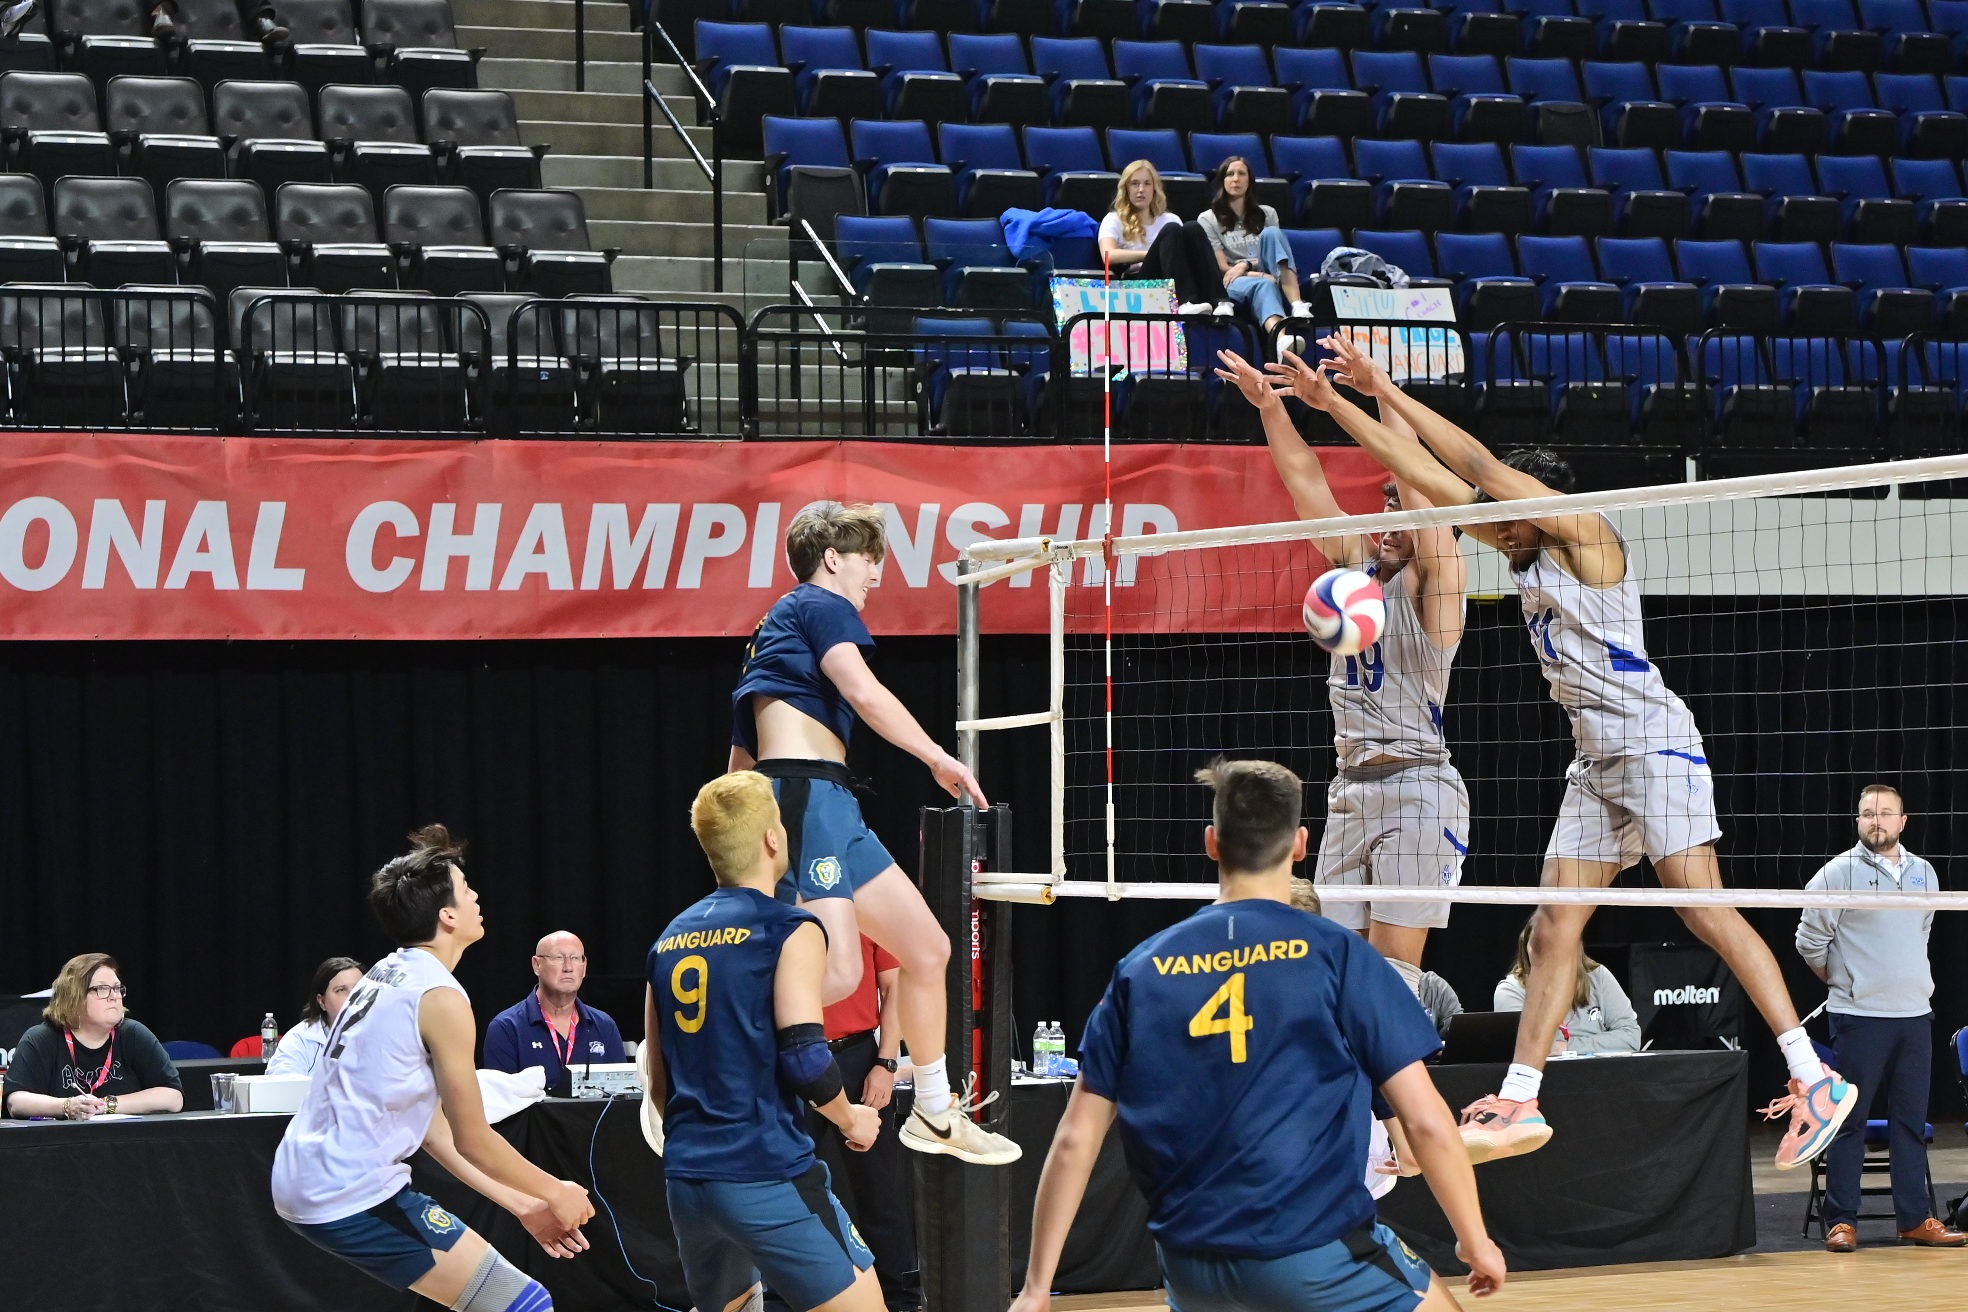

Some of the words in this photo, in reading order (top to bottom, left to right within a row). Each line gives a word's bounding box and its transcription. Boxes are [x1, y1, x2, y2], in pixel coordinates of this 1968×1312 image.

[0, 496, 305, 592] ONAL
[346, 500, 1178, 593] CHAMPINSHIP
[657, 927, 751, 954] VANGUARD
[1152, 939, 1309, 976] VANGUARD
[671, 954, 709, 1034] 9
[1188, 972, 1254, 1063] 4
[1653, 984, 1720, 1006] molten
